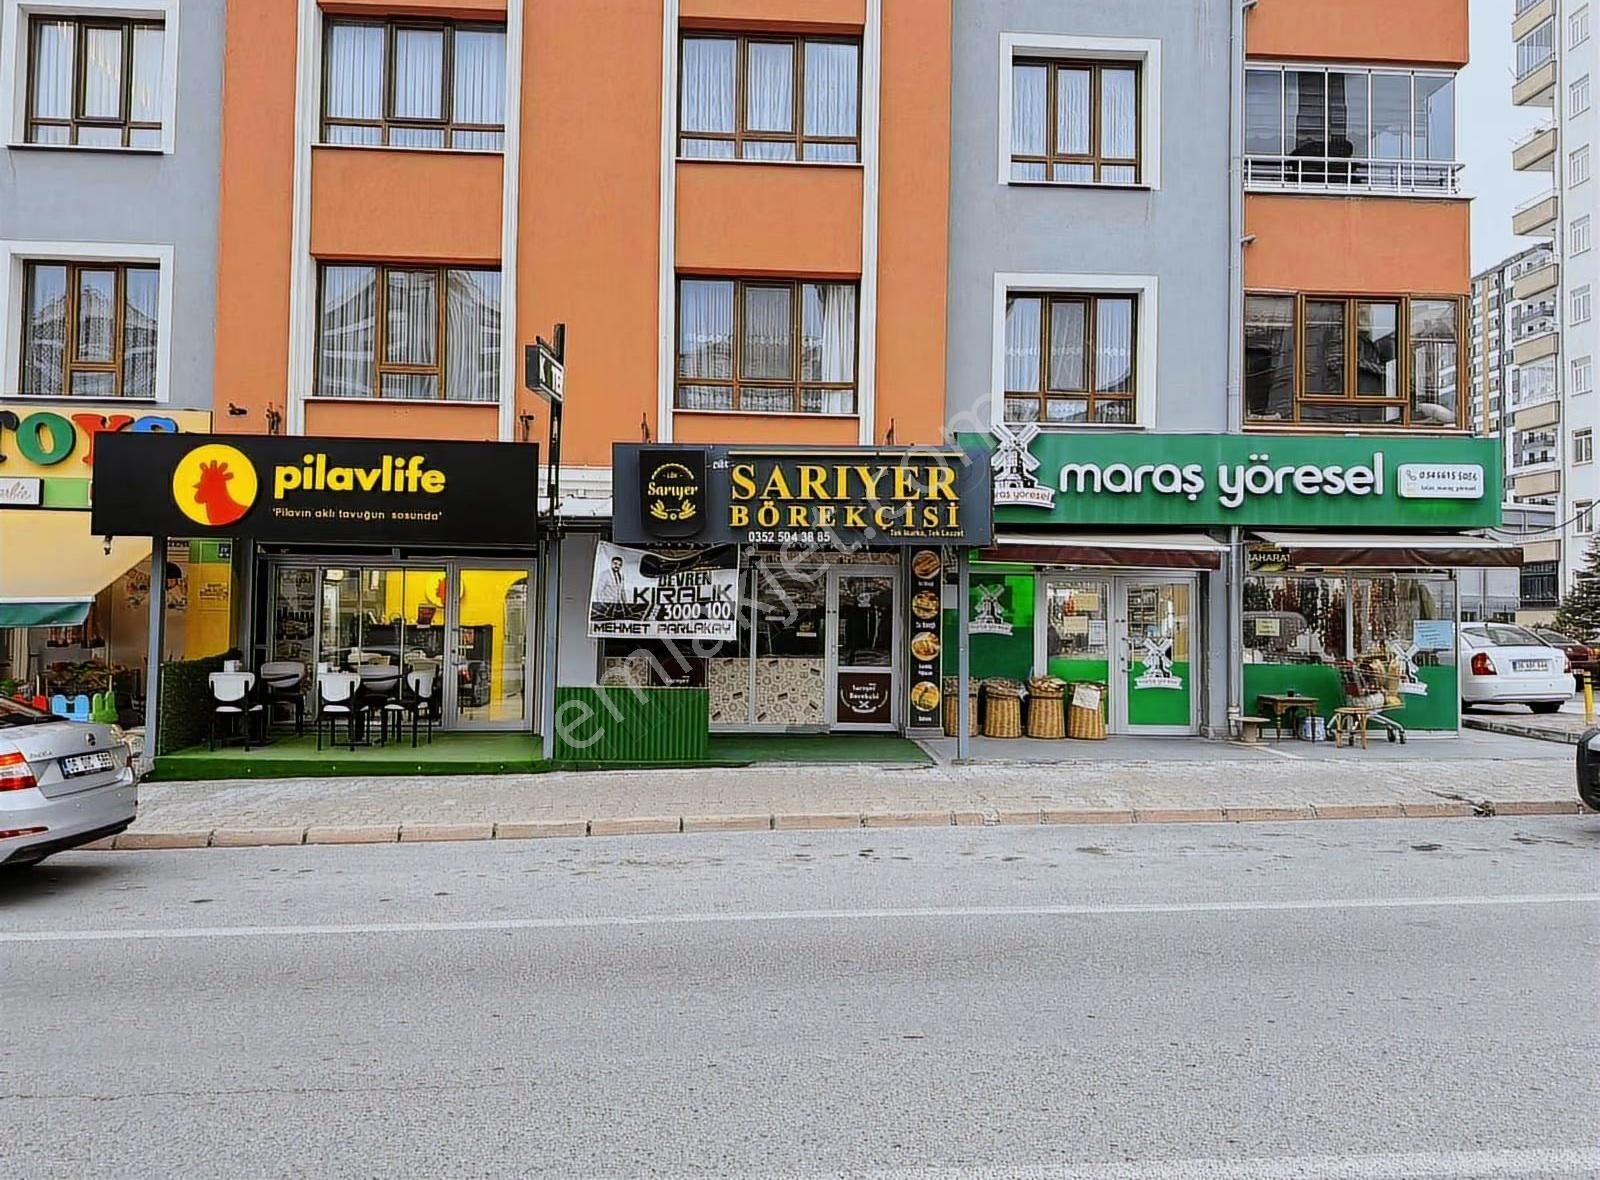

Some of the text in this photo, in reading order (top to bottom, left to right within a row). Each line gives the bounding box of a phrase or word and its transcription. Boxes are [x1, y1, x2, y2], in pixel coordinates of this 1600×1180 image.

[274, 453, 446, 499] pilavlife
[731, 464, 960, 500] SARIYER
[1060, 452, 1384, 508] maraş yöresel
[728, 500, 960, 531] BÖREKÇİSİ
[748, 531, 831, 543] 0352 504 38 85
[634, 584, 733, 606] KIRALIK
[664, 604, 701, 620] 3000
[705, 602, 731, 619] 100
[593, 623, 731, 634] MEHMET PARLAKAY
